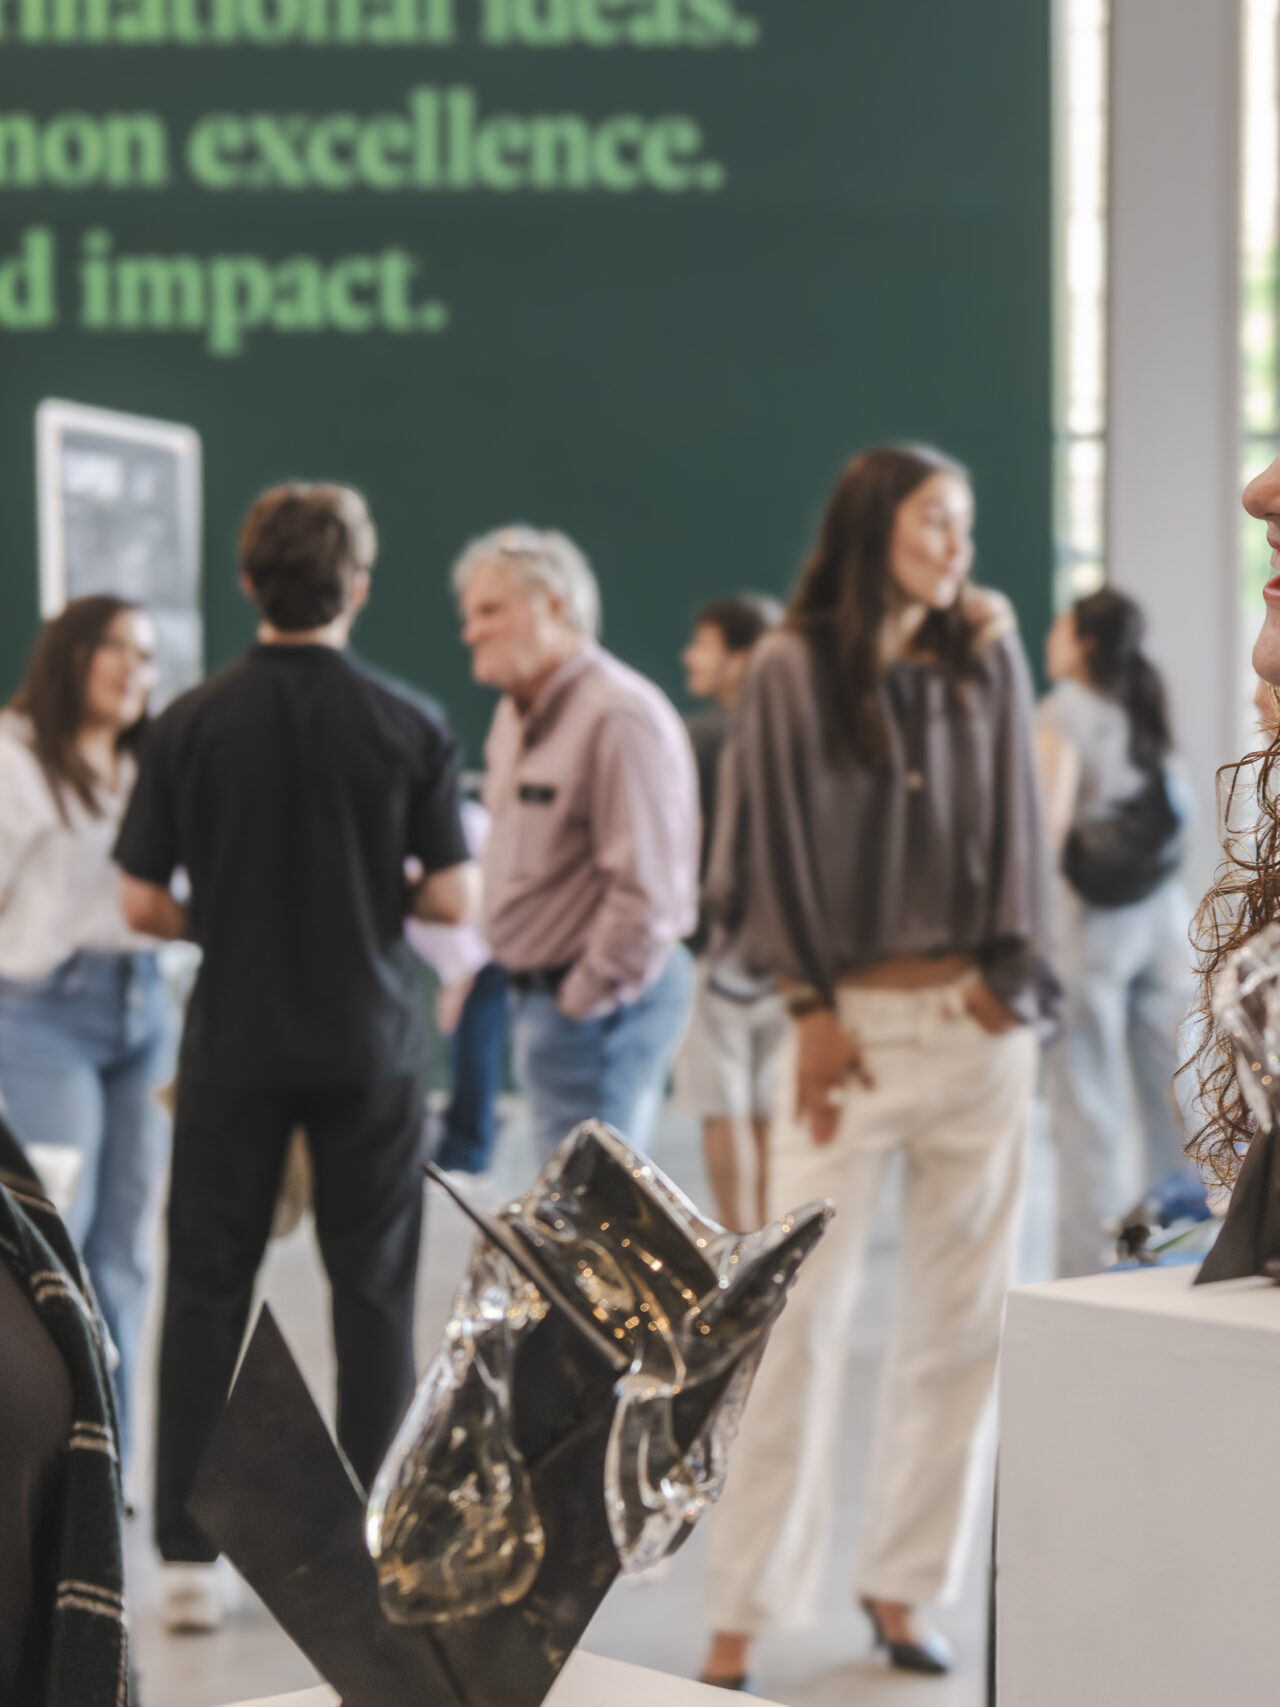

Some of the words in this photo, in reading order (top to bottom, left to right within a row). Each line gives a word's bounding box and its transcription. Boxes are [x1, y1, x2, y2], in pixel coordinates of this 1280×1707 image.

[0, 0, 453, 44] matona
[188, 86, 722, 189] excellence.
[82, 228, 445, 354] impact.
